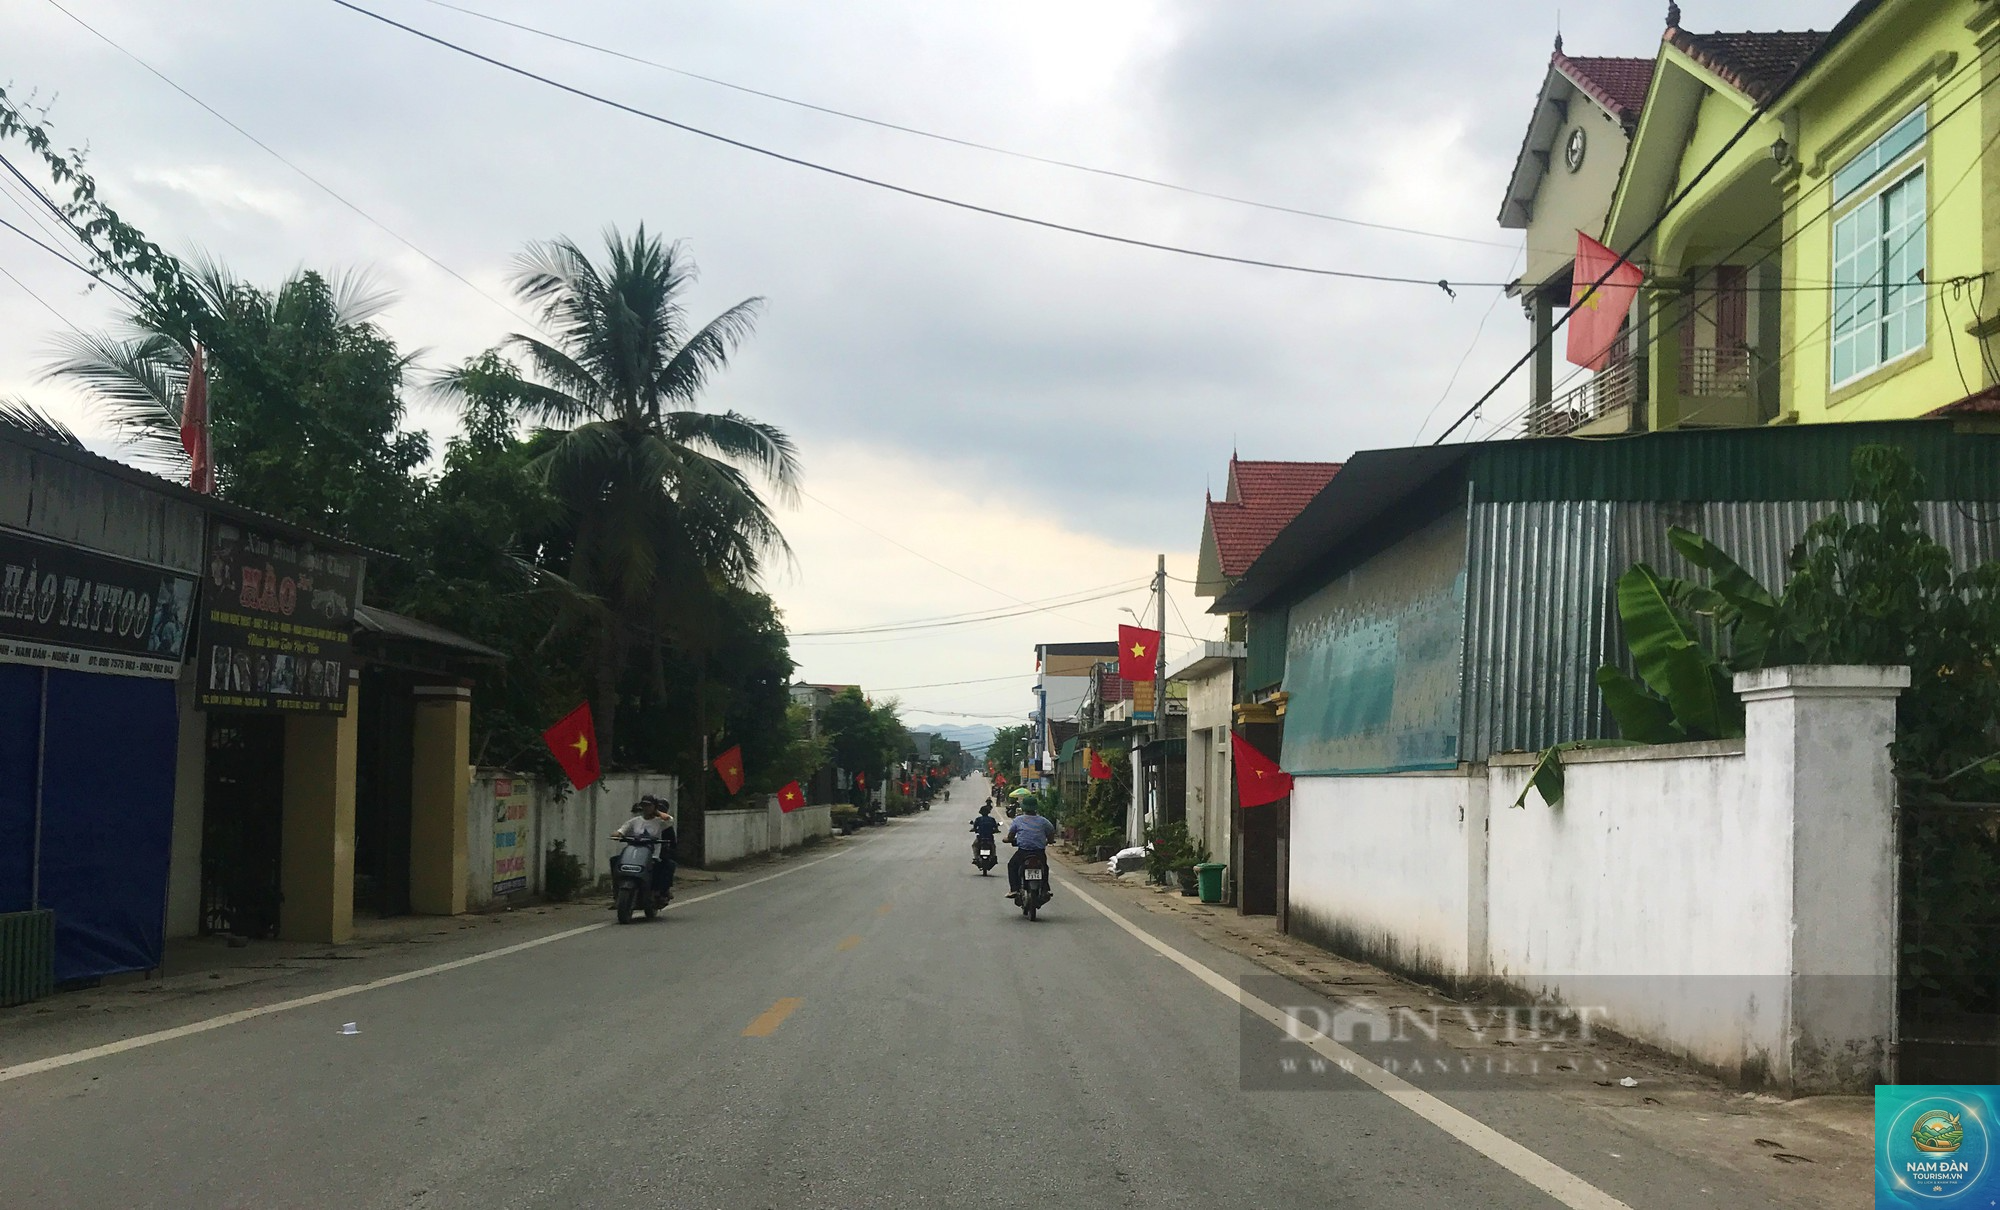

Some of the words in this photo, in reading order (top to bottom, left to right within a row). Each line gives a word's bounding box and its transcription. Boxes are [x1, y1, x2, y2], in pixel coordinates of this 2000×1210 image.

[59, 576, 152, 640] TATTOO
[15, 645, 31, 658] NAM
[70, 653, 80, 663] AN
